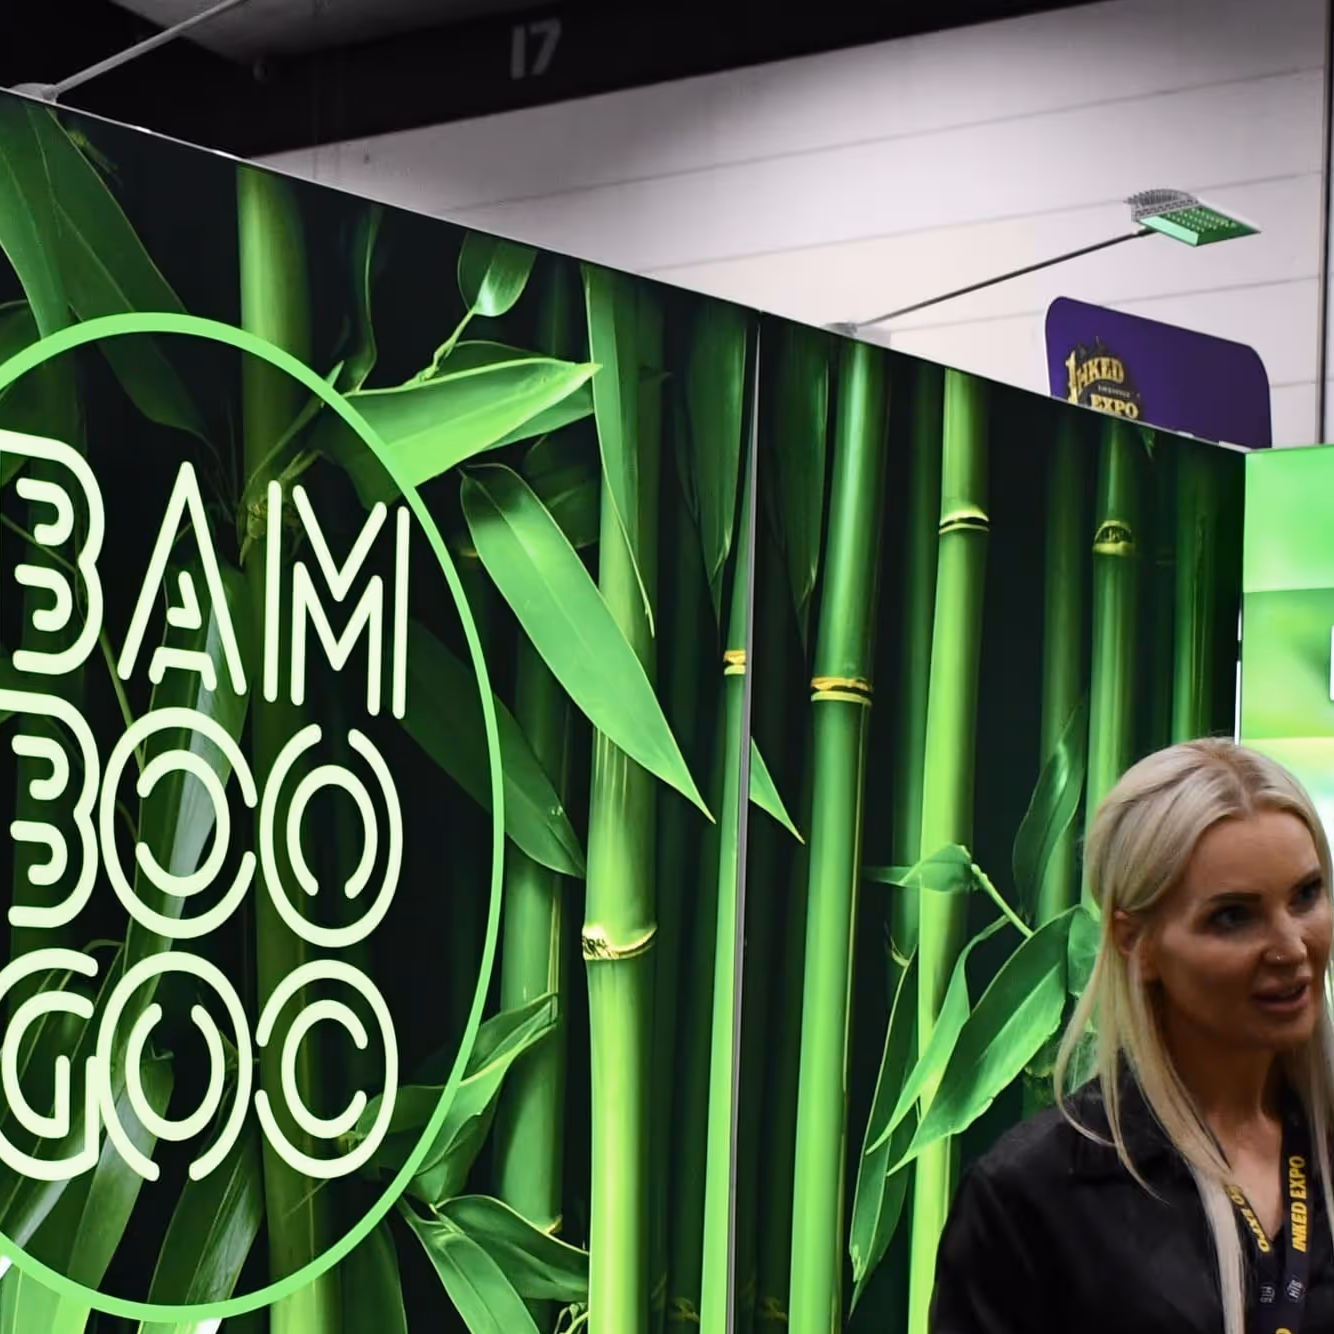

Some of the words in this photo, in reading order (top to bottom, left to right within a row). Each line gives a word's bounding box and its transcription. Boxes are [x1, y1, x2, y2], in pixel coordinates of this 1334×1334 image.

[511, 18, 561, 80] 17
[1090, 393, 1139, 419] EXPO
[1288, 1155, 1307, 1200] EXPO
[1241, 1208, 1271, 1253] EXPO
[1291, 1200, 1307, 1253] INKED
